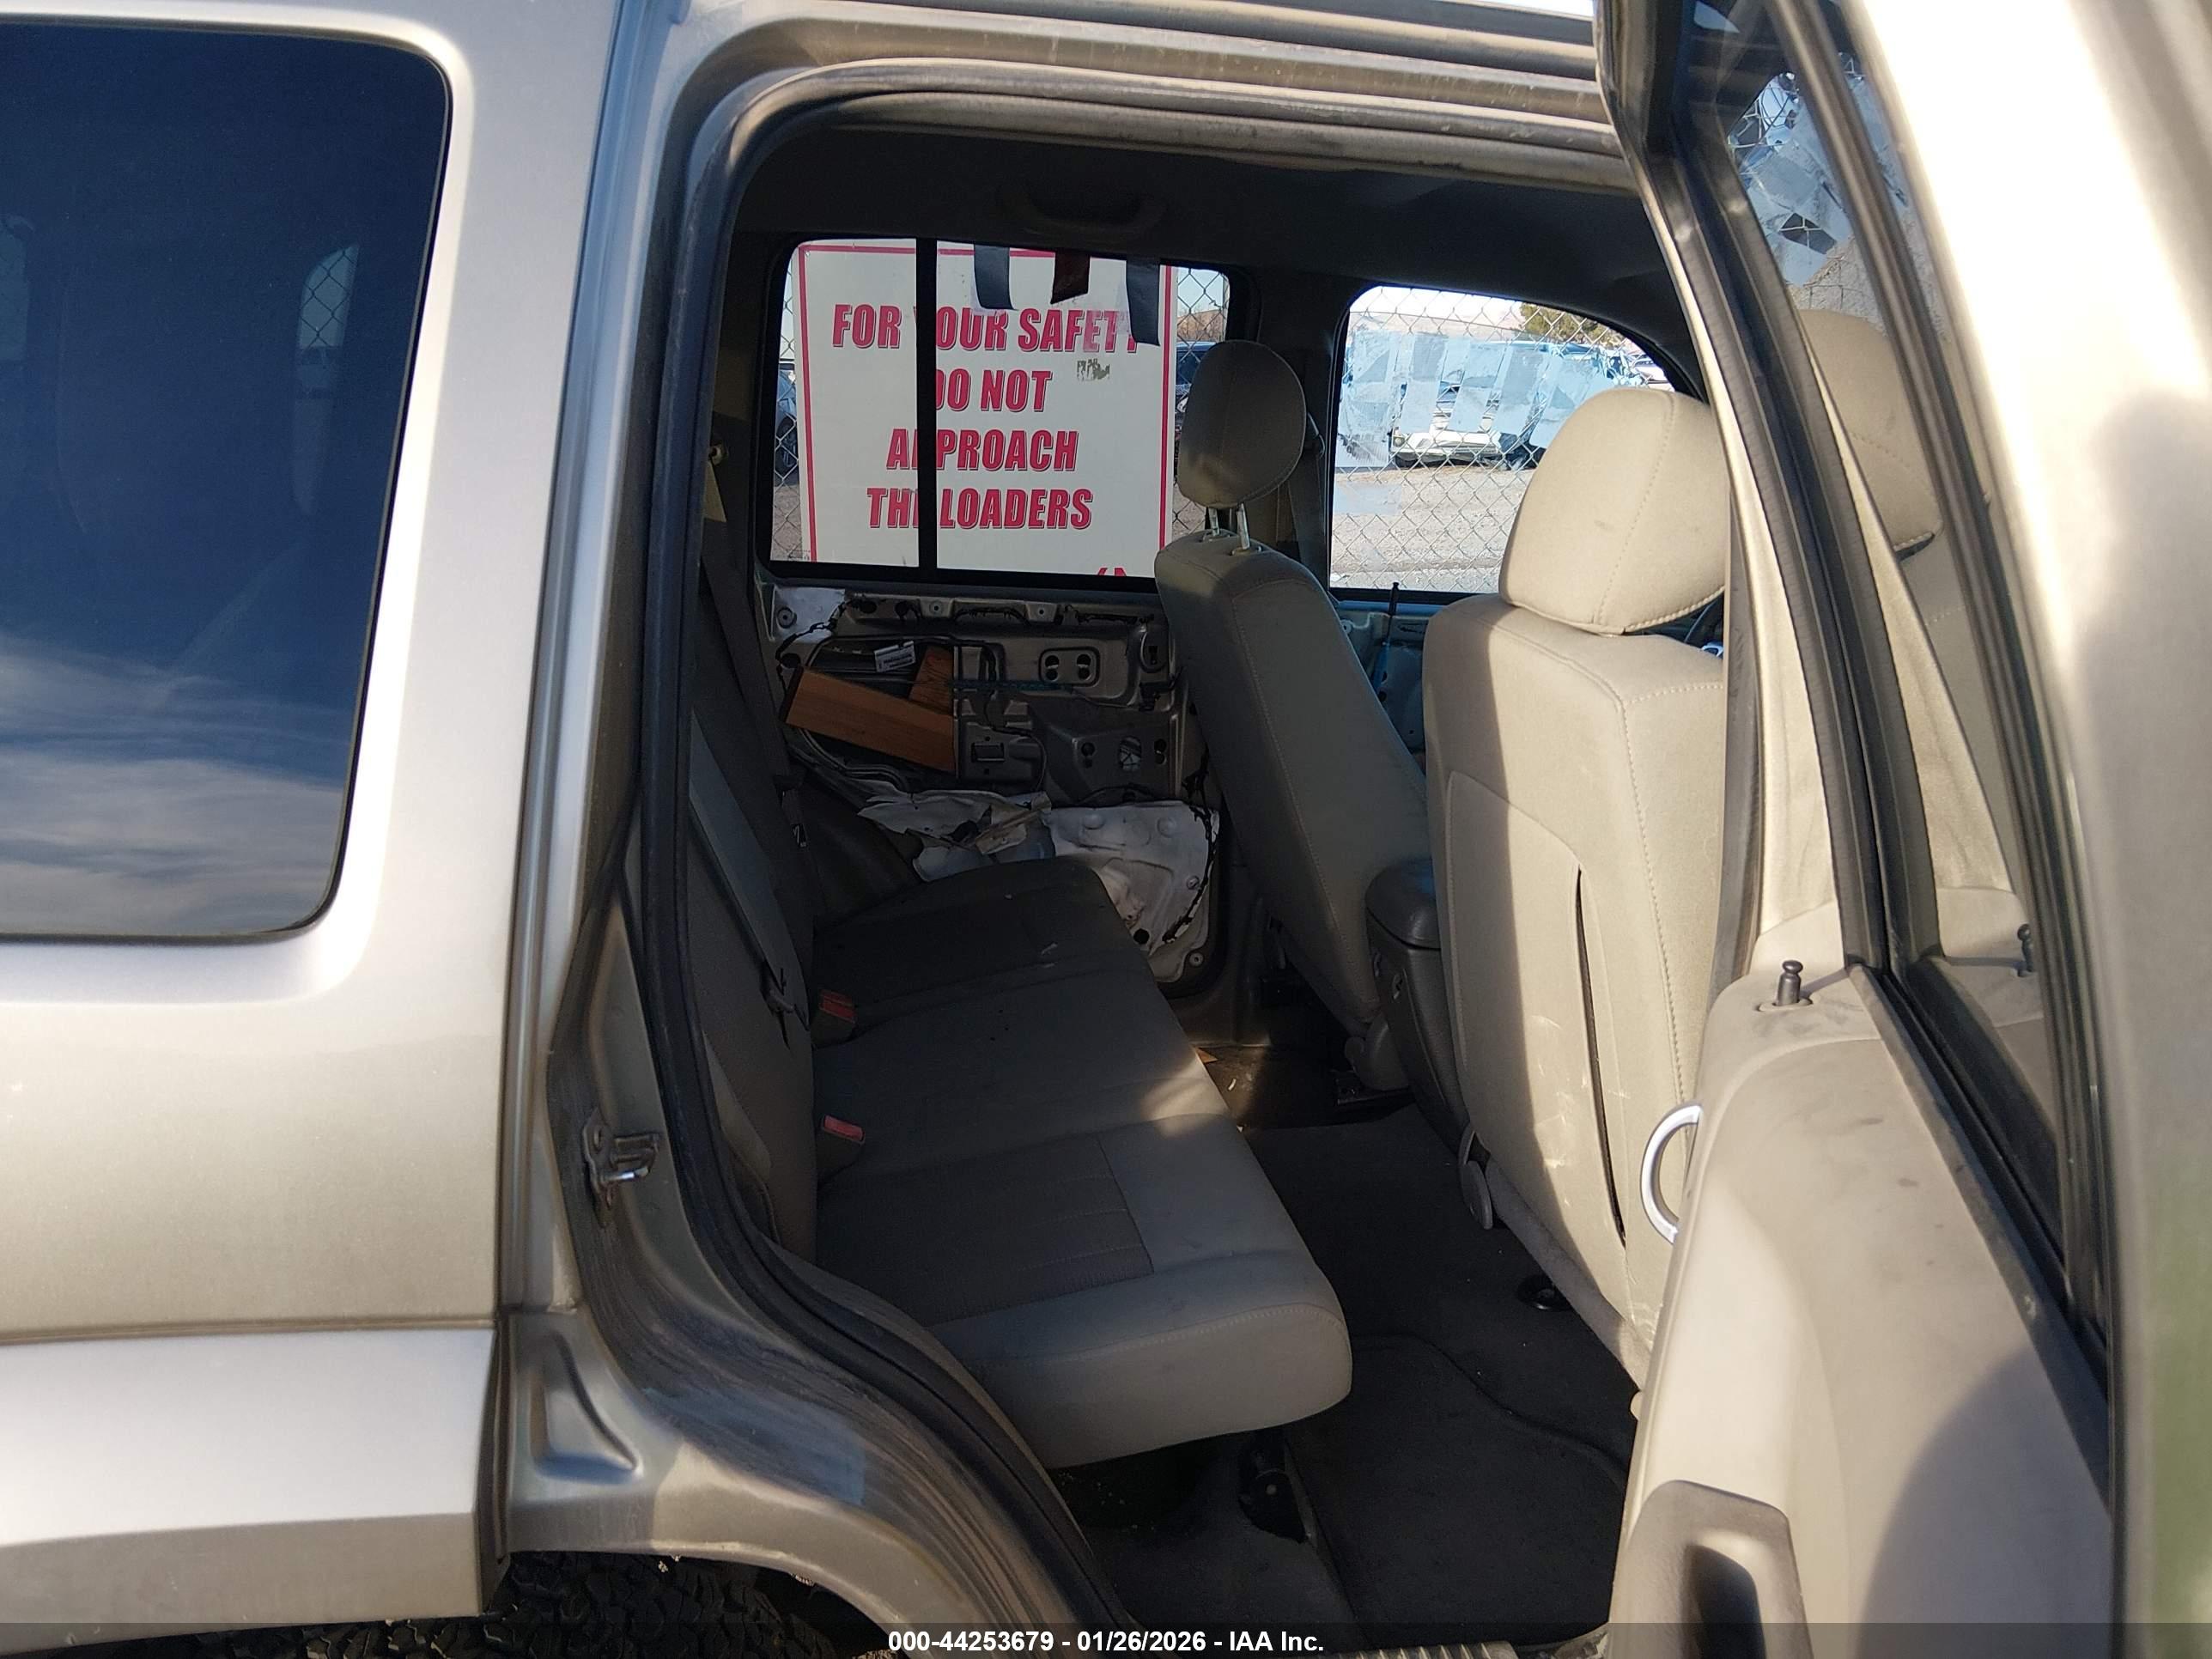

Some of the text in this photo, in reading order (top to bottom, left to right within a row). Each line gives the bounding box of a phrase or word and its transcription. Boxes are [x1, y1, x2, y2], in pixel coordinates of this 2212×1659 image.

[832, 304, 901, 349] FOR
[913, 305, 1007, 351] OUR
[981, 369, 1052, 413] NOT
[867, 487, 1093, 530] TH LOADERS
